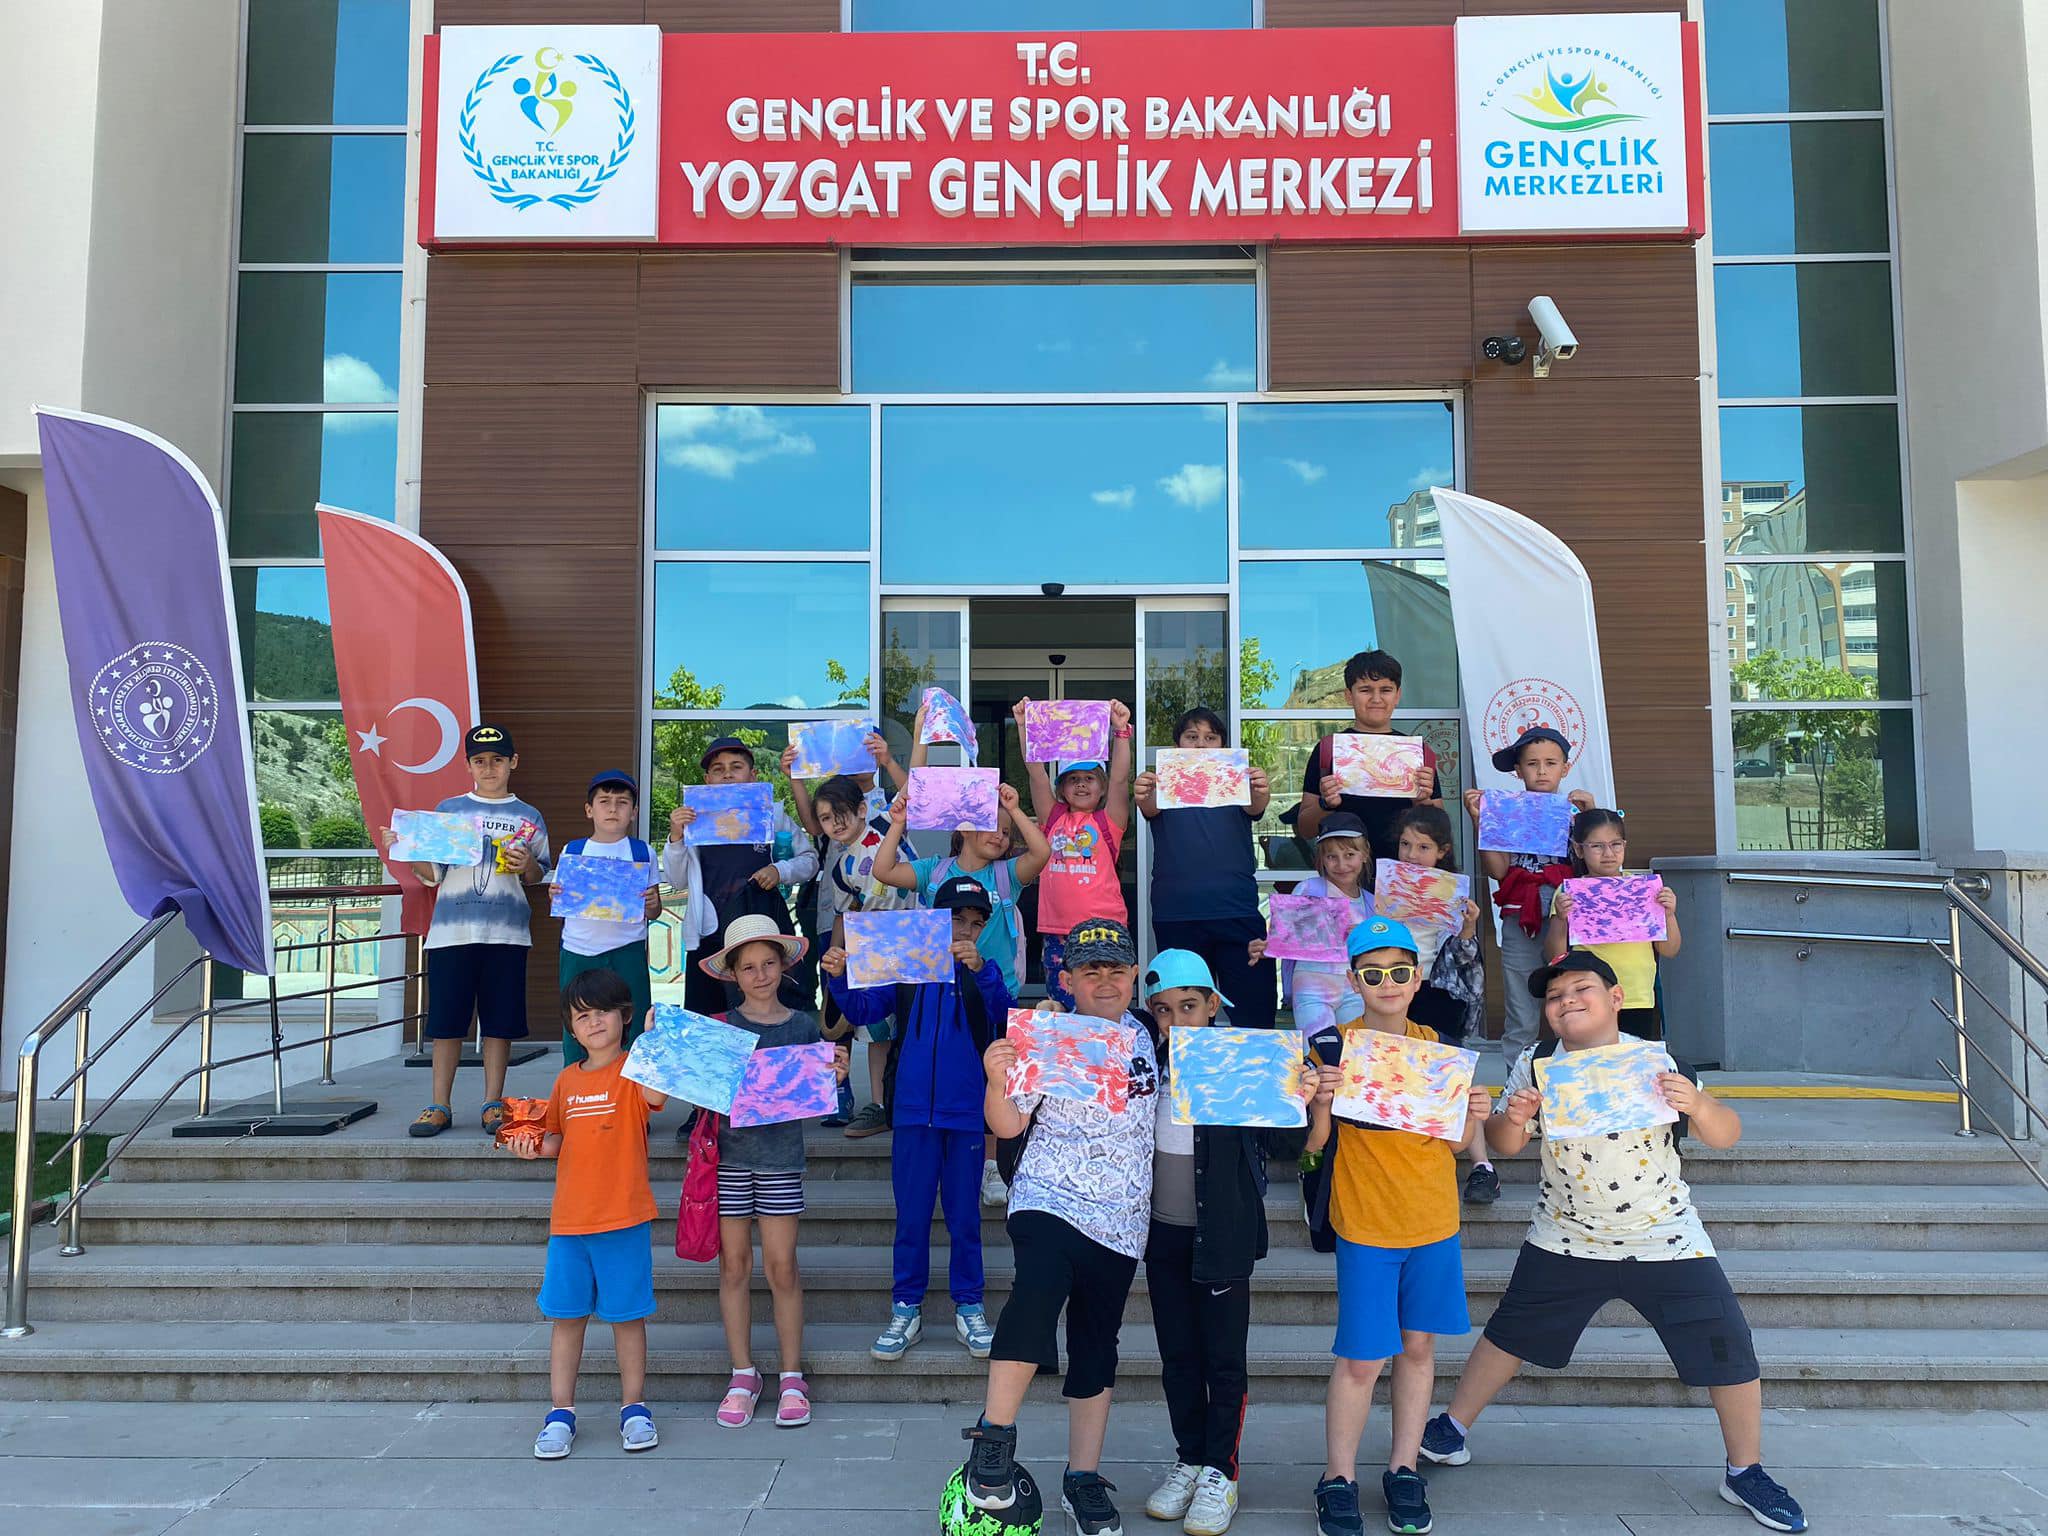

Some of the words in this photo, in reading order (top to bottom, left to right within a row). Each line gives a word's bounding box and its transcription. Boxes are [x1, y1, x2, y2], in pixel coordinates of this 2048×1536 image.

[1017, 42, 1091, 86] T.C.
[1496, 52, 1545, 85] GENÇLİK
[1548, 47, 1563, 56] VE
[1568, 47, 1601, 57] SPOR
[1604, 52, 1662, 100] BAKANLIĞI
[726, 86, 927, 149] GENÇLİK
[936, 98, 993, 142] VE
[1009, 96, 1130, 141] SPOR
[1145, 86, 1391, 140] BAKANLIĞI
[536, 141, 557, 153] T.C.
[549, 154, 564, 166] VE
[566, 154, 600, 166] SPOR
[1484, 136, 1659, 170] GENÇLİK
[511, 167, 581, 180] BAKANLIĞI
[680, 158, 912, 220] YOZGAT
[929, 144, 1172, 228] GENÇLİK
[1190, 139, 1432, 217] MERKEZİ
[1484, 171, 1663, 196] MERKEZLERİ
[1079, 927, 1119, 944] CITY
